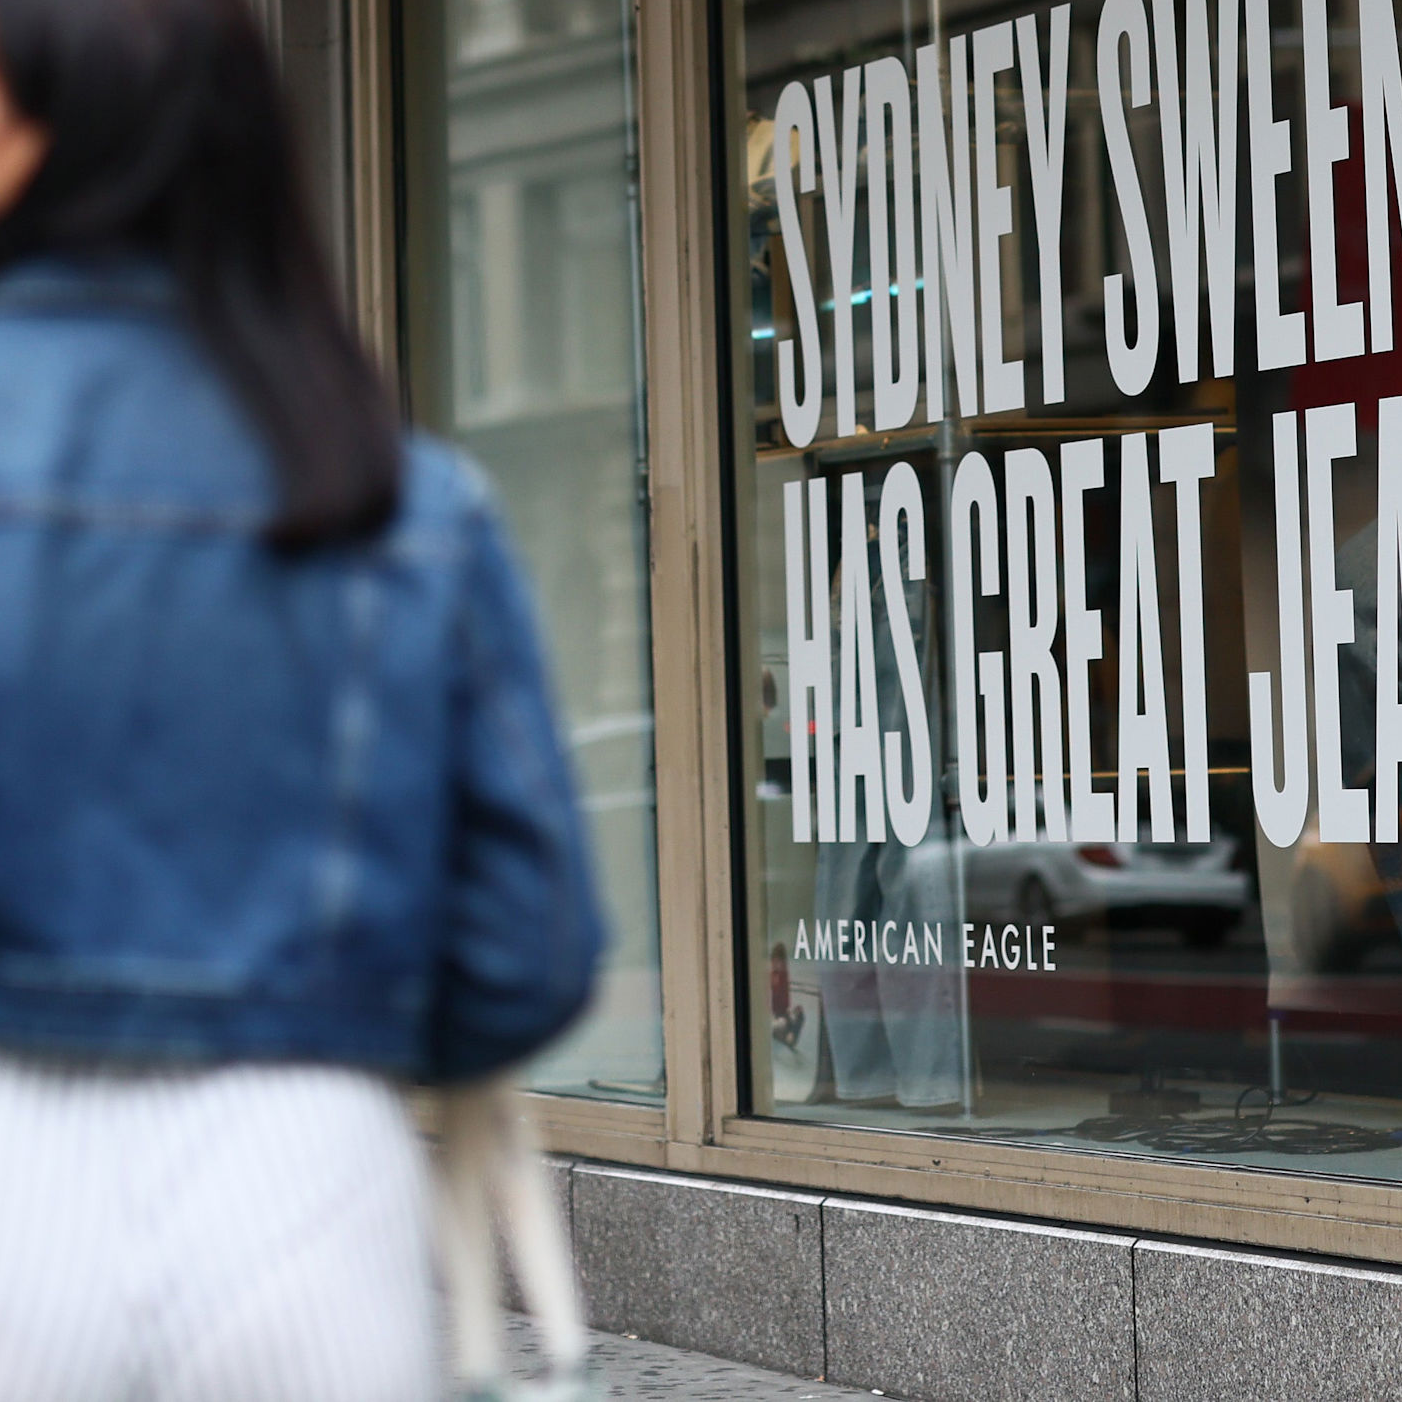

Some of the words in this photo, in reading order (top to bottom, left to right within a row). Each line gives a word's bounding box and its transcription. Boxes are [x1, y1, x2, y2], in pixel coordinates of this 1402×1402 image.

[774, 3, 1071, 449] SYDNEY
[784, 461, 932, 848] HAS
[951, 422, 1215, 849] GREAT
[794, 918, 943, 967] AMERICAN
[962, 924, 1057, 972] EAGLE
